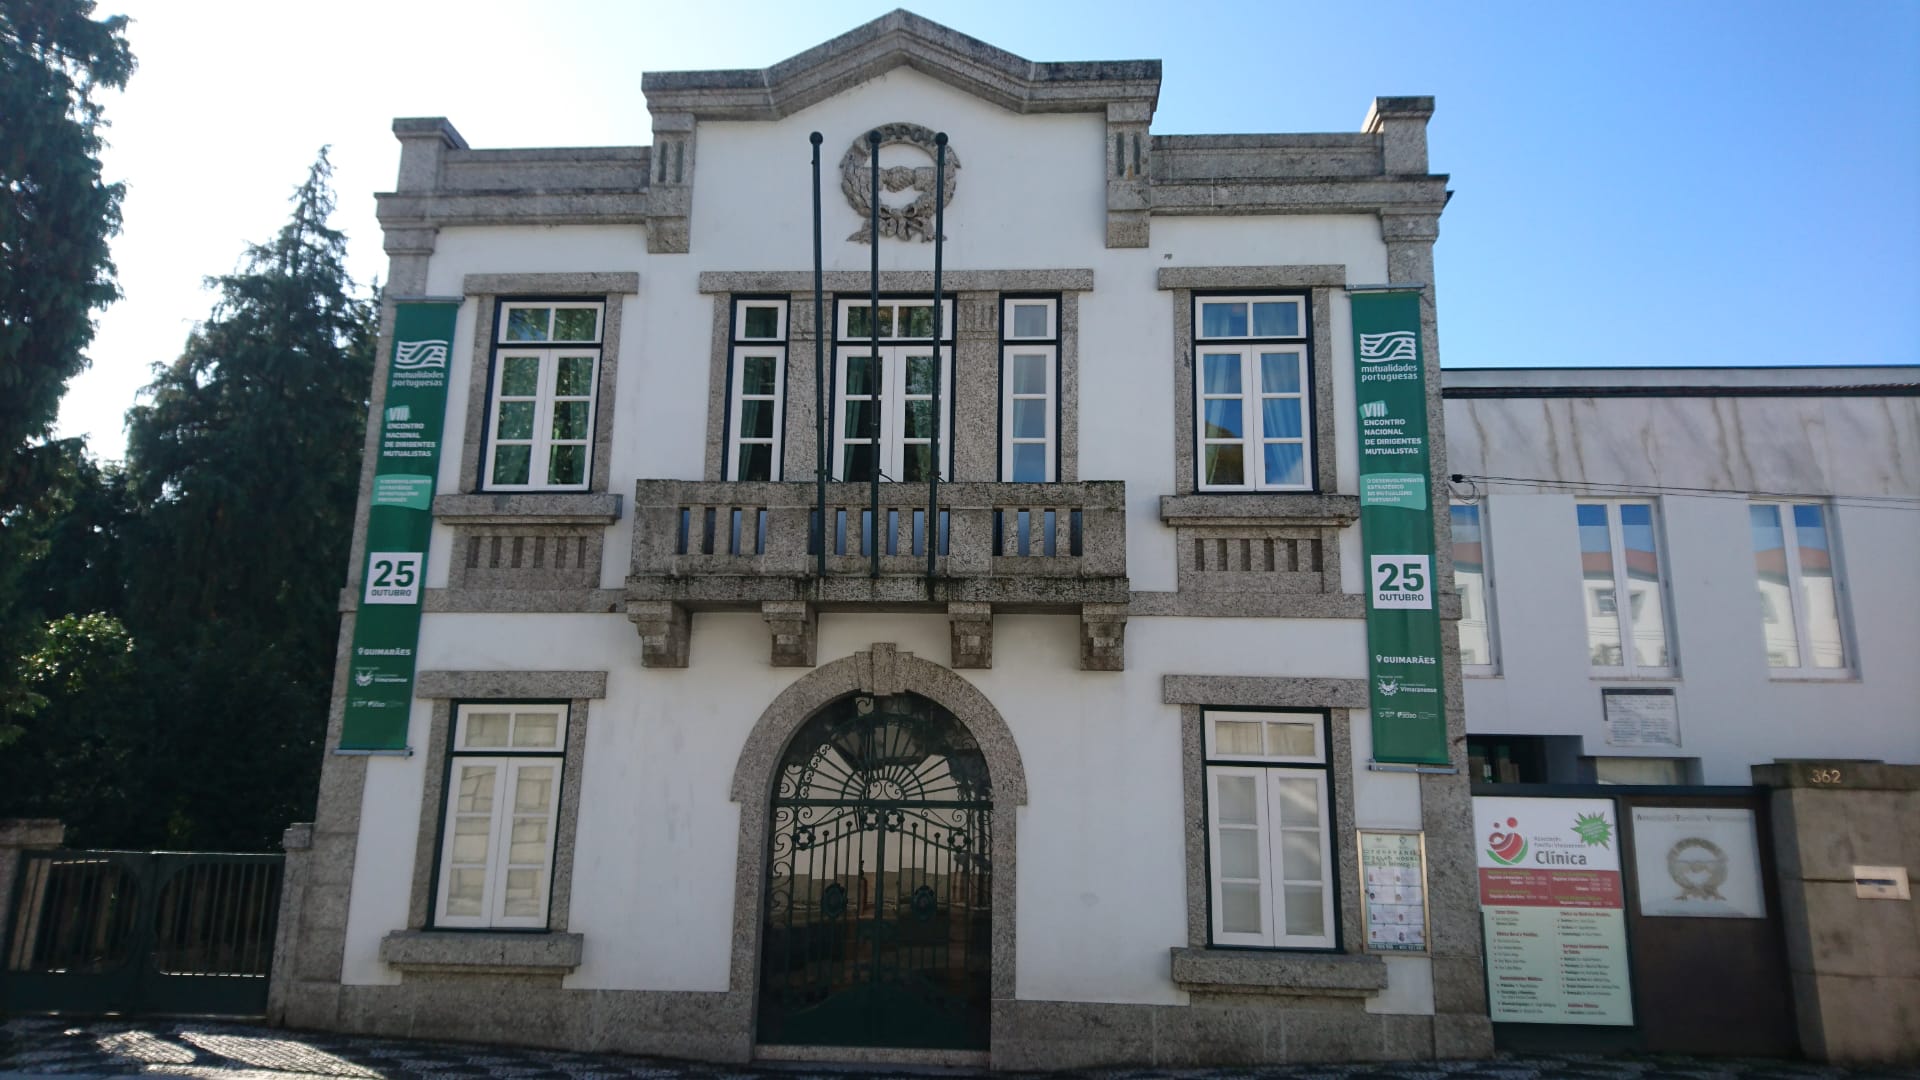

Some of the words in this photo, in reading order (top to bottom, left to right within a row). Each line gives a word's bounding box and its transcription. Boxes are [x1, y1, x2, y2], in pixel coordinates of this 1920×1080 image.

[1361, 363, 1418, 373] mutualidades
[1361, 373, 1418, 383] portuguesas
[1363, 403, 1385, 417] VIII
[1376, 437, 1422, 445] DIRIGENTES
[1365, 447, 1419, 455] MUTUALISTAS
[373, 559, 415, 588] 25
[1377, 562, 1425, 592] 25
[371, 589, 412, 597] OUTUBRO
[1379, 593, 1425, 602] OUTUBRO
[364, 647, 412, 656] GUIMARÃES
[1383, 655, 1436, 665] GUIMARÃES
[1811, 769, 1842, 784] 362
[1535, 850, 1588, 866] Clínica
